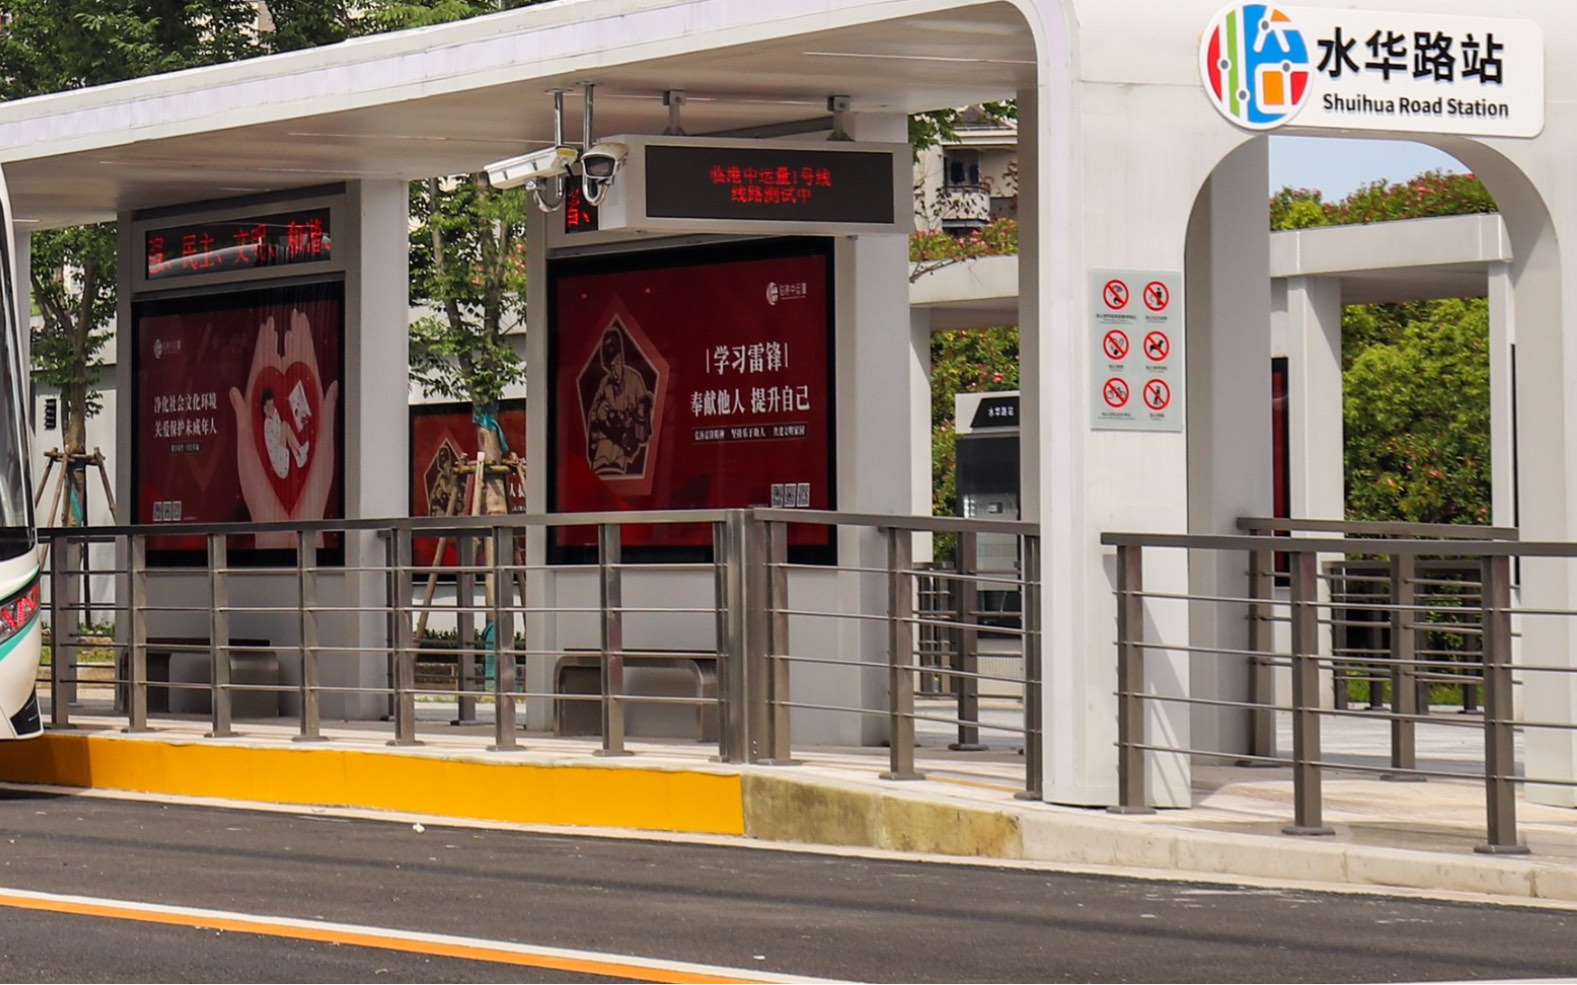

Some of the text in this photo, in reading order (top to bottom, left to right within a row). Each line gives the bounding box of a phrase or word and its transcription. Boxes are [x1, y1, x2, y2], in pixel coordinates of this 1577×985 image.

[1317, 27, 1505, 84] 水华路站
[1323, 93, 1510, 117] Shuihua Road Station
[154, 392, 217, 413] 净化社会文化环境
[690, 385, 810, 417] 奉献他人 提升自己
[154, 418, 217, 438] 关爱保护未成年人
